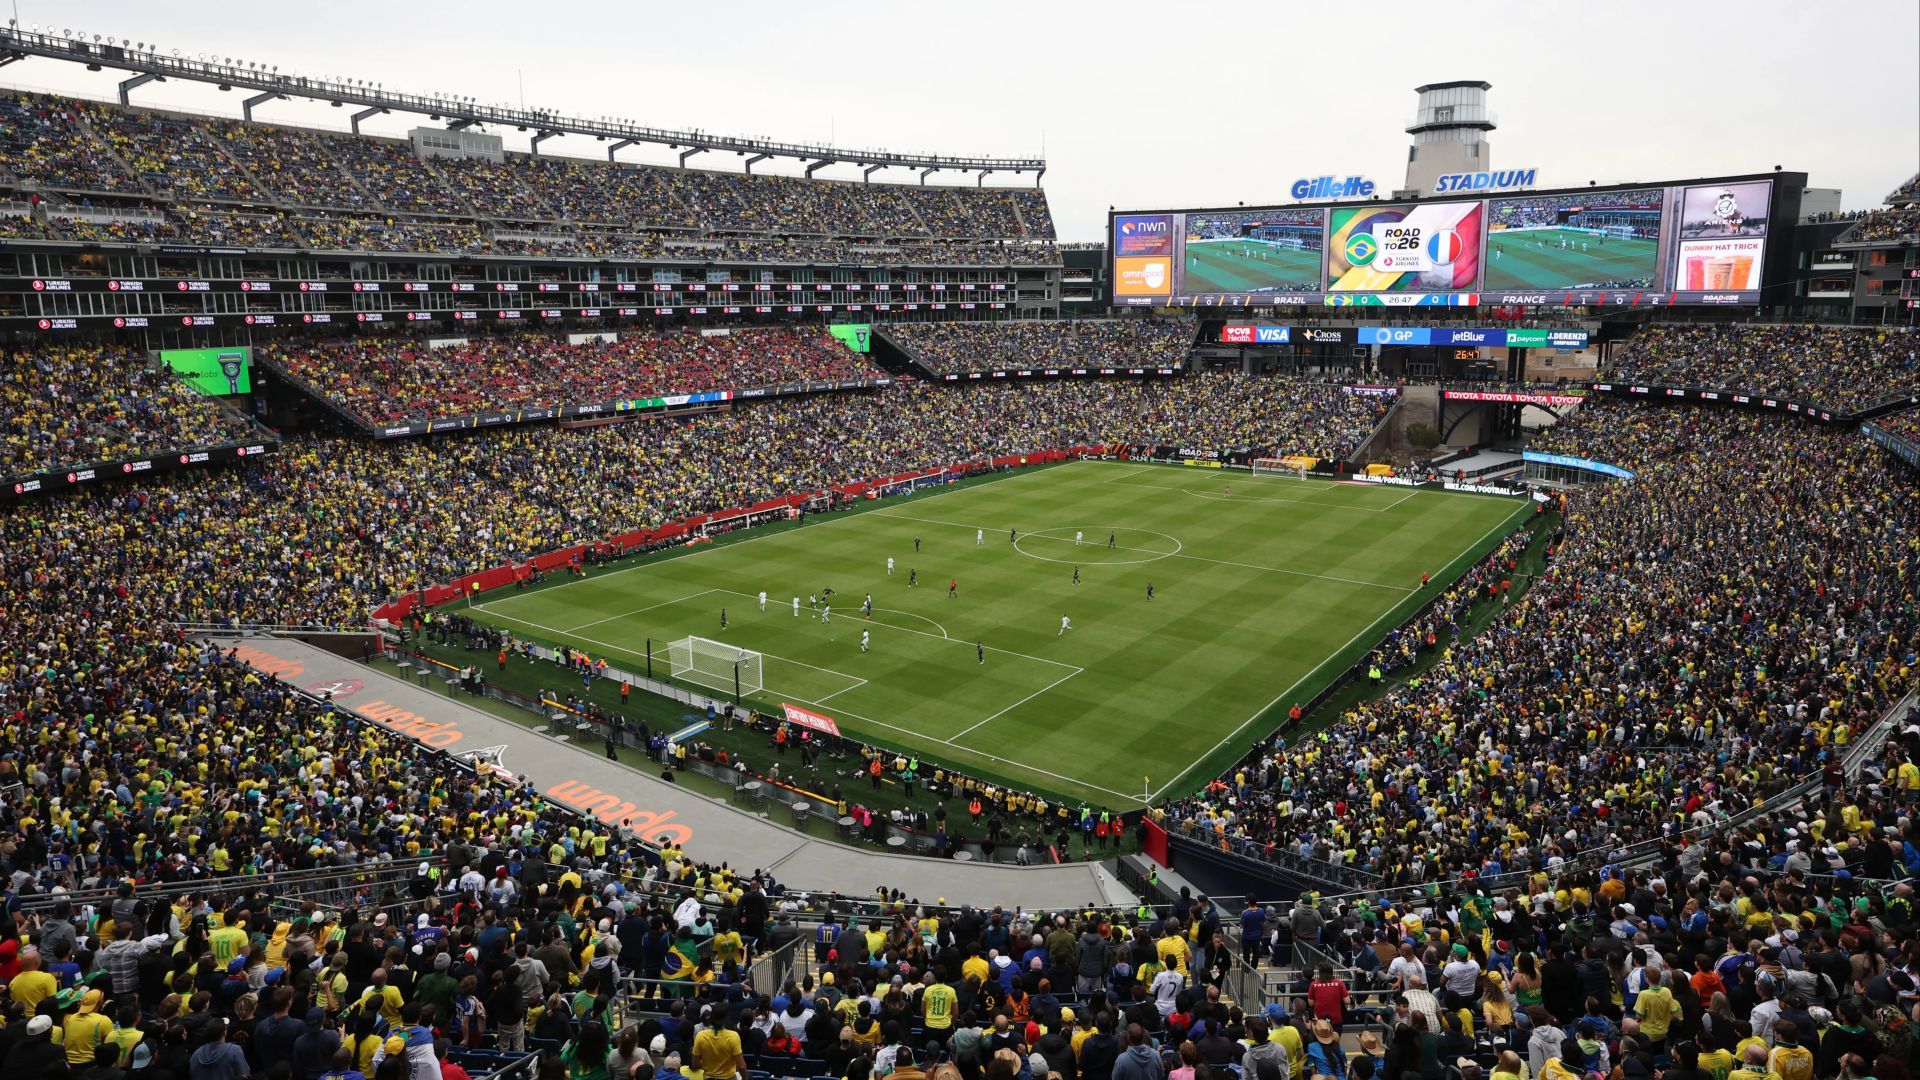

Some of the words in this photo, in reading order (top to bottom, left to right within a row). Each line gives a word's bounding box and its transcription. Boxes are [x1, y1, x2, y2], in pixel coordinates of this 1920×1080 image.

[1436, 169, 1535, 191] STADIUM
[1291, 177, 1375, 199] Gillette
[1138, 221, 1167, 232] nwn
[1384, 228, 1421, 238] ROAD
[1361, 296, 1368, 304] 0
[1432, 296, 1439, 304] 0
[1502, 296, 1545, 304] FRANCE
[1259, 330, 1288, 341] VISA
[1452, 332, 1485, 342] jetBlue
[1456, 350, 1480, 359] 26:47
[1449, 392, 1478, 400] TOYOTA
[1481, 392, 1512, 401] TOYOTA
[1515, 394, 1548, 402] TOYOTA
[579, 405, 602, 413] BRAZIL
[1179, 448, 1202, 457] ROAD
[1352, 474, 1413, 486] NIKE.COM/FOOTBALL
[1444, 482, 1510, 495] NIKE.COM/FOOTBALL
[546, 781, 693, 848] Optum
[823, 930, 833, 943] 10
[216, 940, 230, 960] 10
[1168, 982, 1177, 998] 7
[986, 996, 995, 1010] 9
